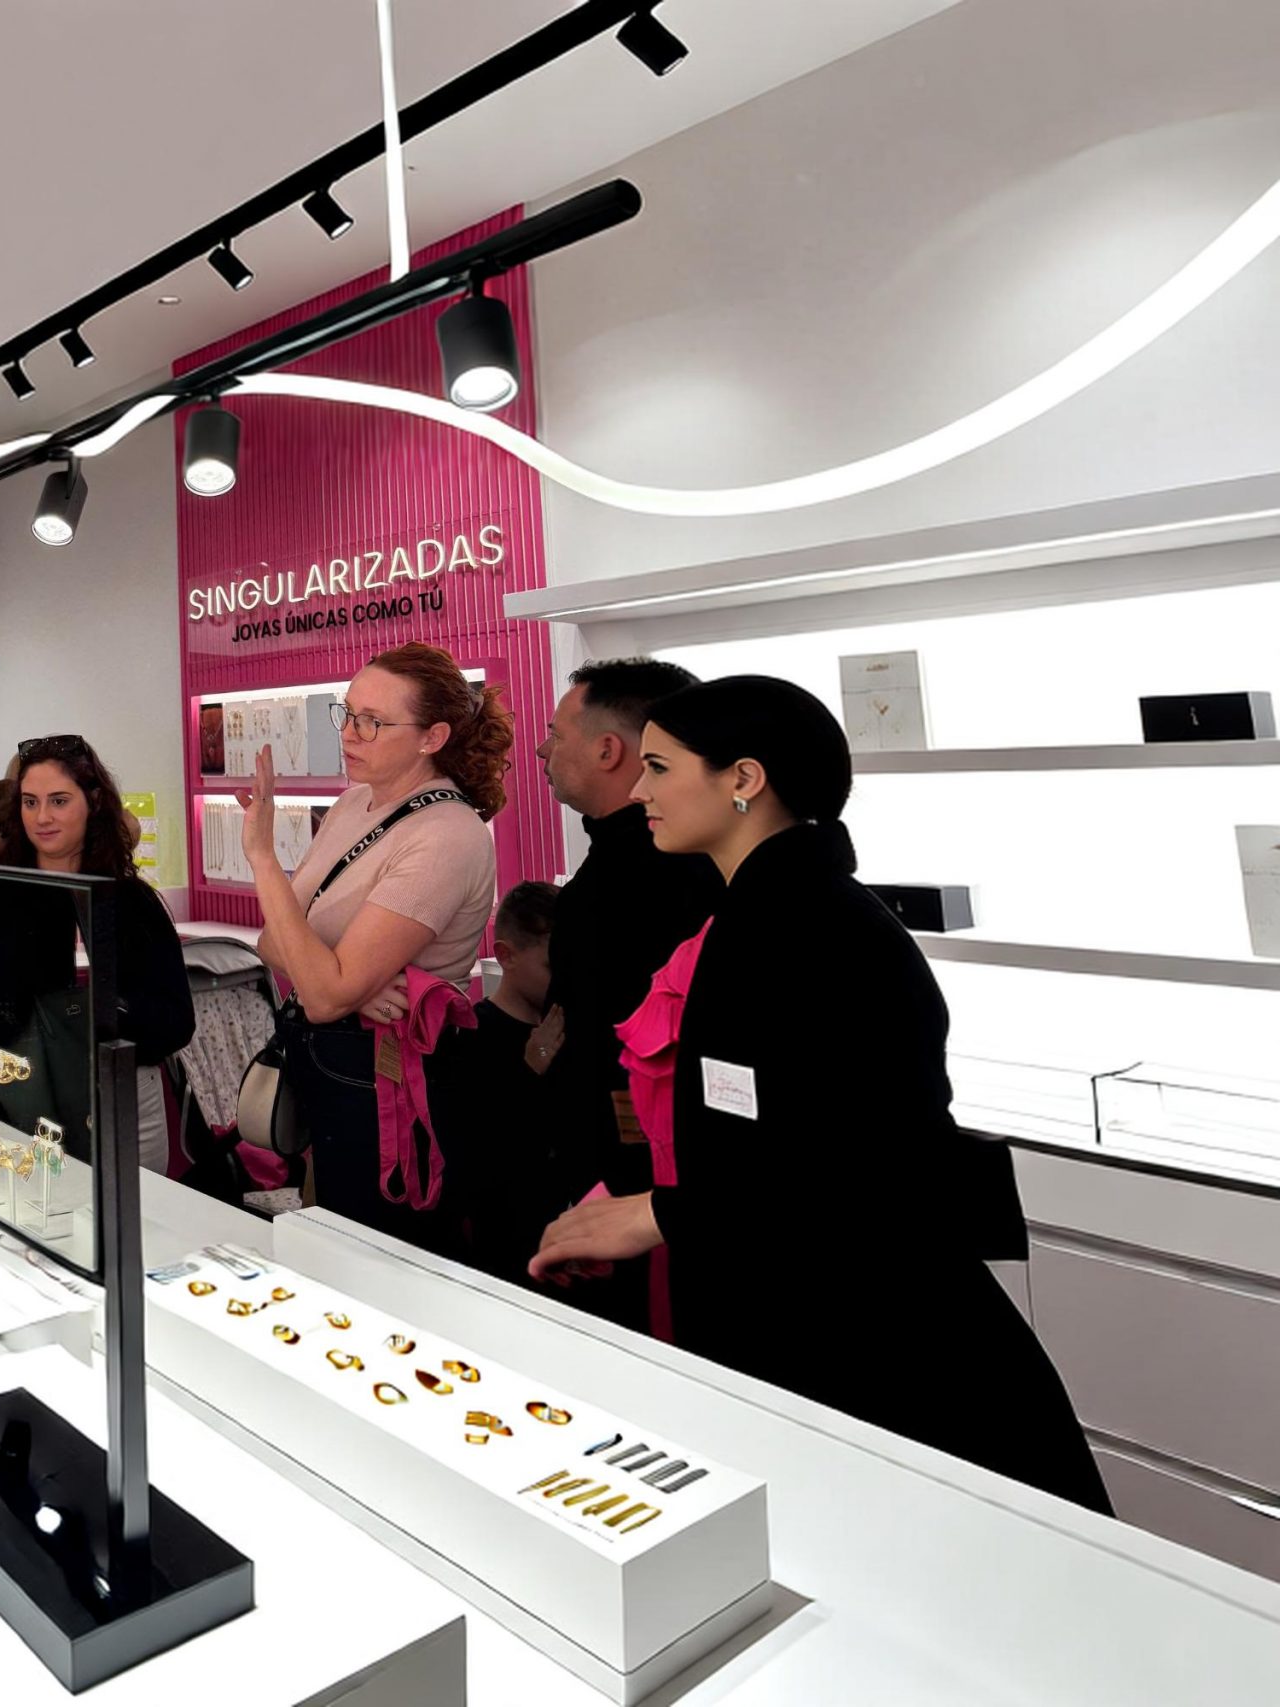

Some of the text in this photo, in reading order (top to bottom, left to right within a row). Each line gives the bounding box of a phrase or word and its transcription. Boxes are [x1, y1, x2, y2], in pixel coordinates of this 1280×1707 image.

[188, 525, 505, 620] SINGULARIZADAS
[231, 585, 443, 643] JOYAS ÚNICAS COMO TÚ
[342, 825, 384, 863] TOUS
